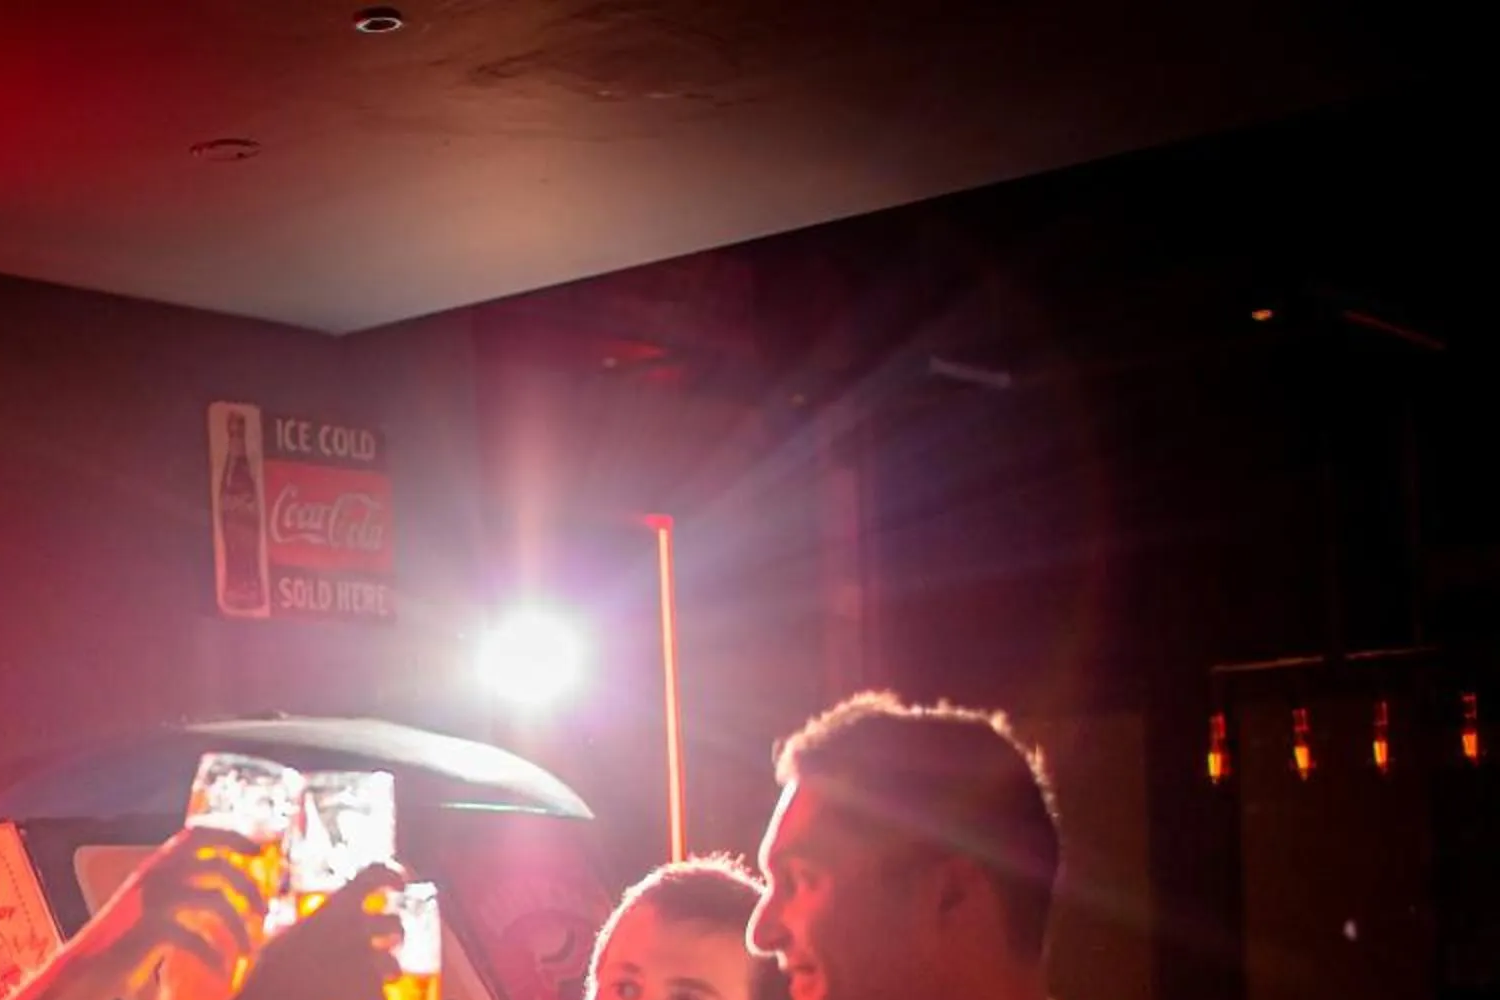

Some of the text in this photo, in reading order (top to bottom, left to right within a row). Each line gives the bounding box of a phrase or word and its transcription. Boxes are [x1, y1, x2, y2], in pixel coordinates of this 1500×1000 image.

[276, 418, 376, 460] ICE COLD
[278, 577, 389, 616] SOLD HERE
